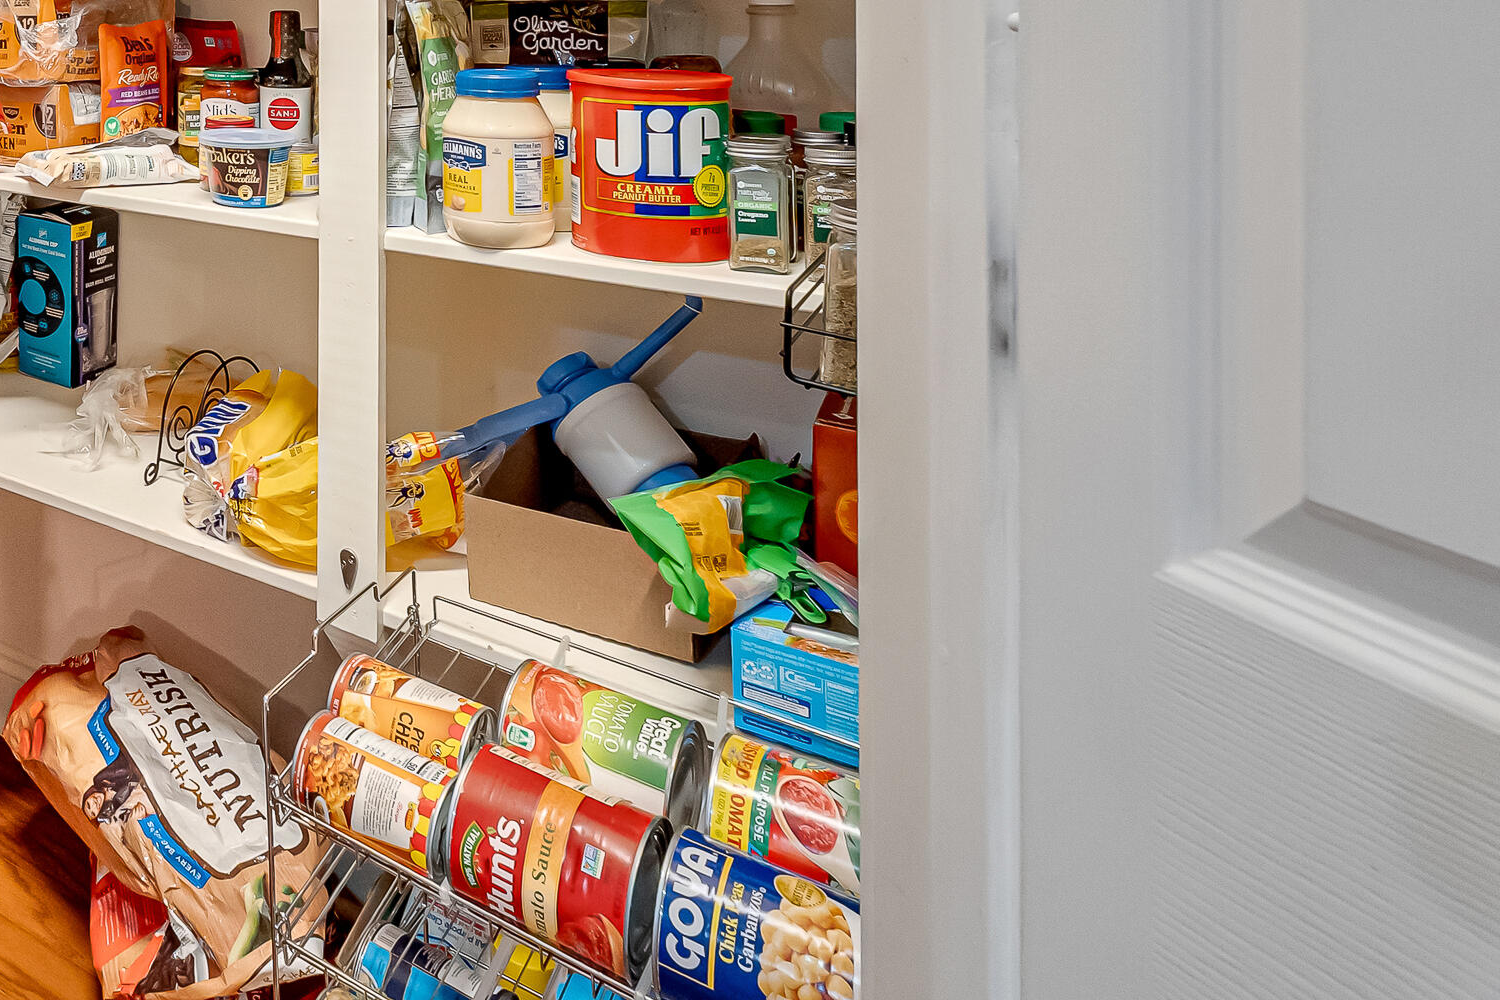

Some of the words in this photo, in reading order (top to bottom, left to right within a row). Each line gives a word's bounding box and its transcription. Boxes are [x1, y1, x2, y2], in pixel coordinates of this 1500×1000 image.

[513, 15, 570, 33] Olive
[121, 35, 153, 53] Ben's
[522, 32, 604, 55] Garden
[120, 89, 134, 99] RED
[270, 109, 298, 117] SAN-J
[595, 107, 721, 178] Jif
[225, 173, 261, 184] Chocolate
[227, 165, 257, 177] Dipping
[616, 182, 675, 195] CREAMY
[612, 191, 646, 202] PEANUT
[648, 194, 682, 203] BUTTER
[96, 256, 107, 265] CUP
[92, 719, 115, 757] ANIMAL
[394, 710, 414, 750] CHE
[584, 692, 619, 747] SAUCE
[603, 700, 637, 753] TOMATO
[636, 716, 658, 752] Value
[138, 668, 267, 833] NUTRISH
[647, 716, 682, 762] Great
[761, 764, 774, 784] ALL
[466, 827, 481, 867] NATURAL
[531, 821, 557, 885] Sauce
[176, 854, 202, 881] EVERY
[486, 815, 525, 920] Hunt's
[531, 891, 546, 938] omato
[665, 846, 718, 970] GOYA
[719, 913, 739, 964] Chick
